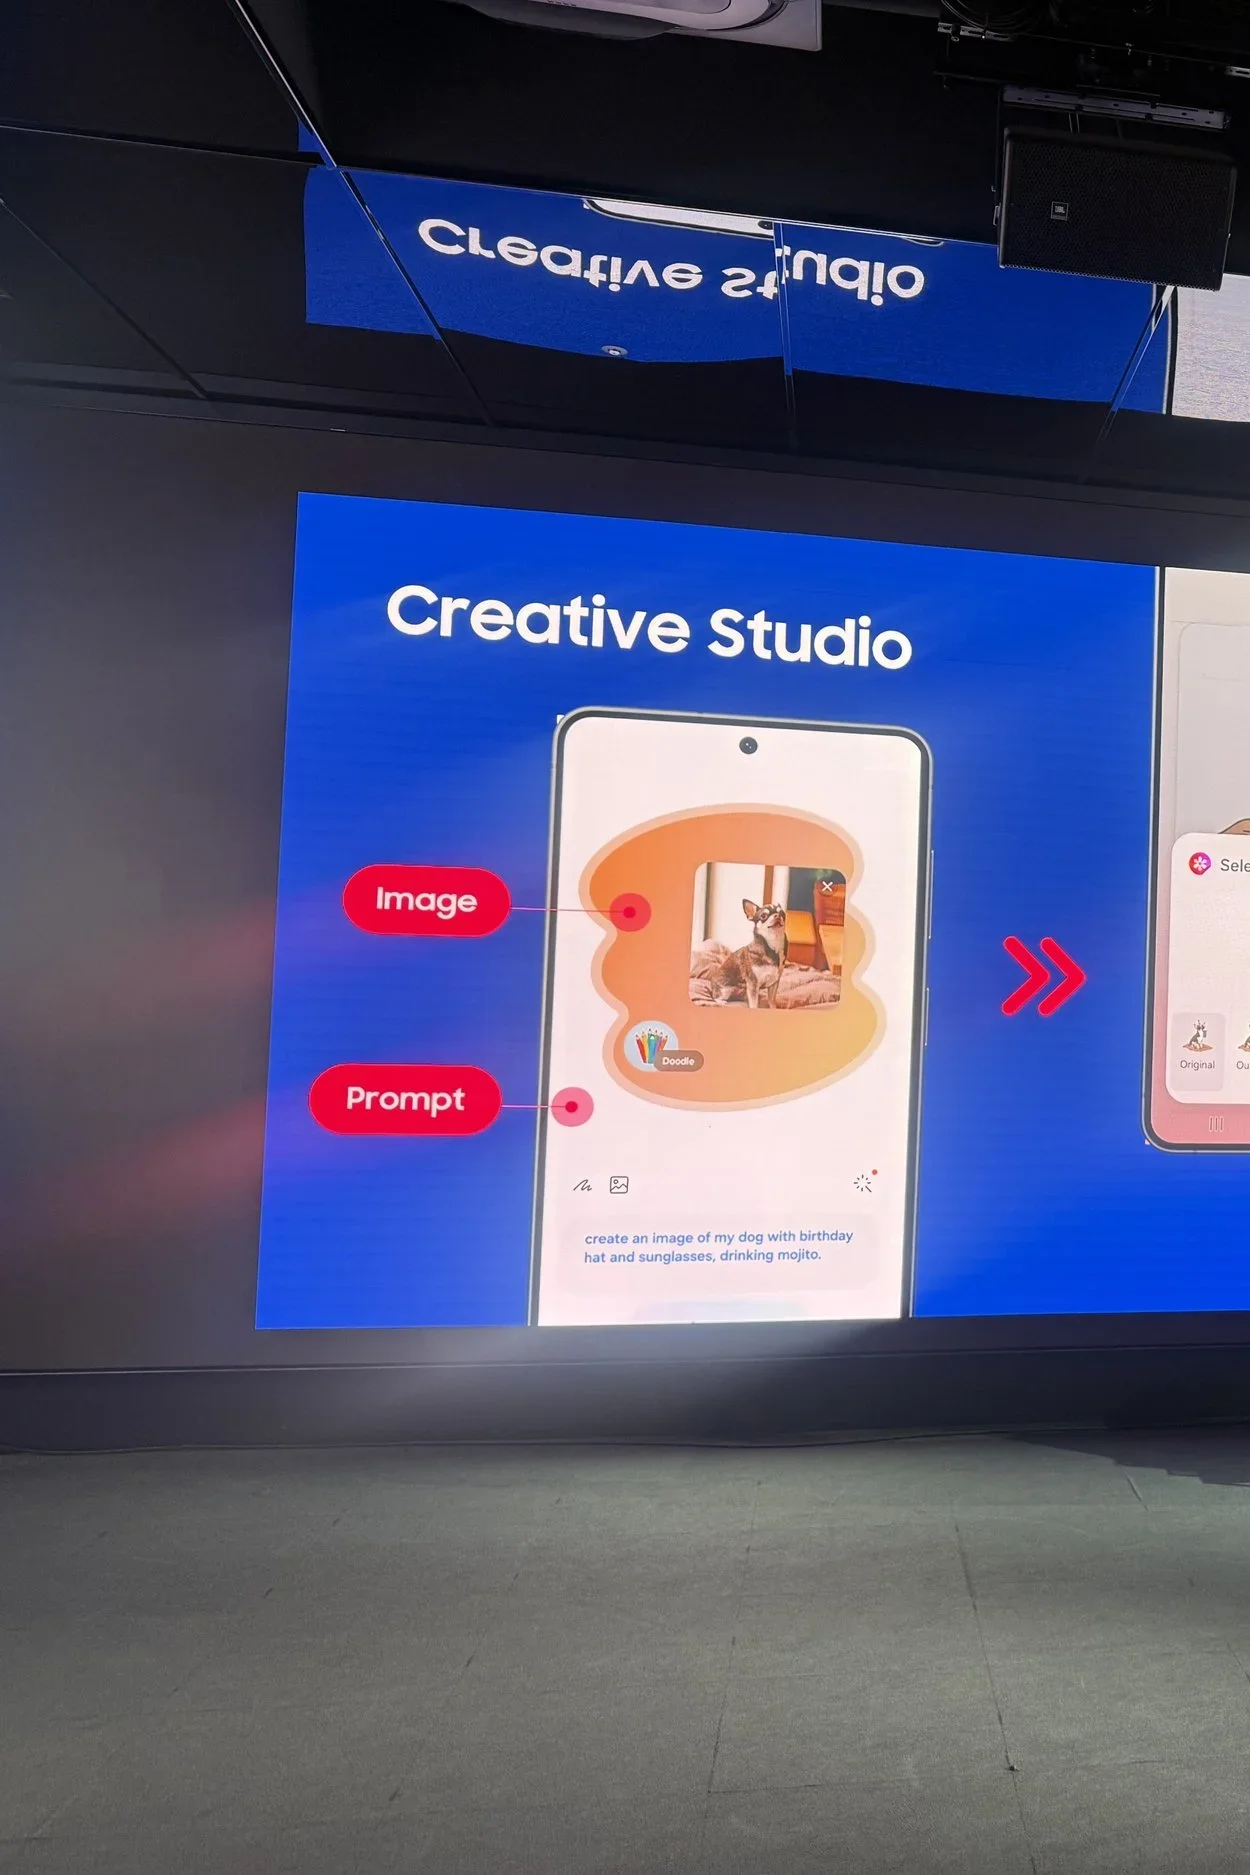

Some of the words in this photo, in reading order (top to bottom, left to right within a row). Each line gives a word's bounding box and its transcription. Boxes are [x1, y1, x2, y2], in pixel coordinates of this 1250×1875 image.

[386, 584, 691, 654] Creative
[706, 607, 914, 670] Studio
[375, 885, 479, 921] Image
[661, 1055, 696, 1067] Doodle
[1179, 1060, 1216, 1072] Original
[346, 1086, 466, 1117] Prompt
[584, 1232, 629, 1245] create
[632, 1233, 649, 1244] an
[652, 1231, 694, 1247] image
[697, 1230, 712, 1244] of
[713, 1232, 735, 1247] my
[738, 1230, 764, 1246] dog
[767, 1229, 797, 1243] with
[799, 1229, 854, 1245] birthday
[584, 1250, 606, 1264] hat
[609, 1250, 636, 1263] and
[638, 1250, 717, 1265] sunglasses,
[719, 1249, 774, 1264] drinking
[777, 1248, 822, 1263] mojito.
